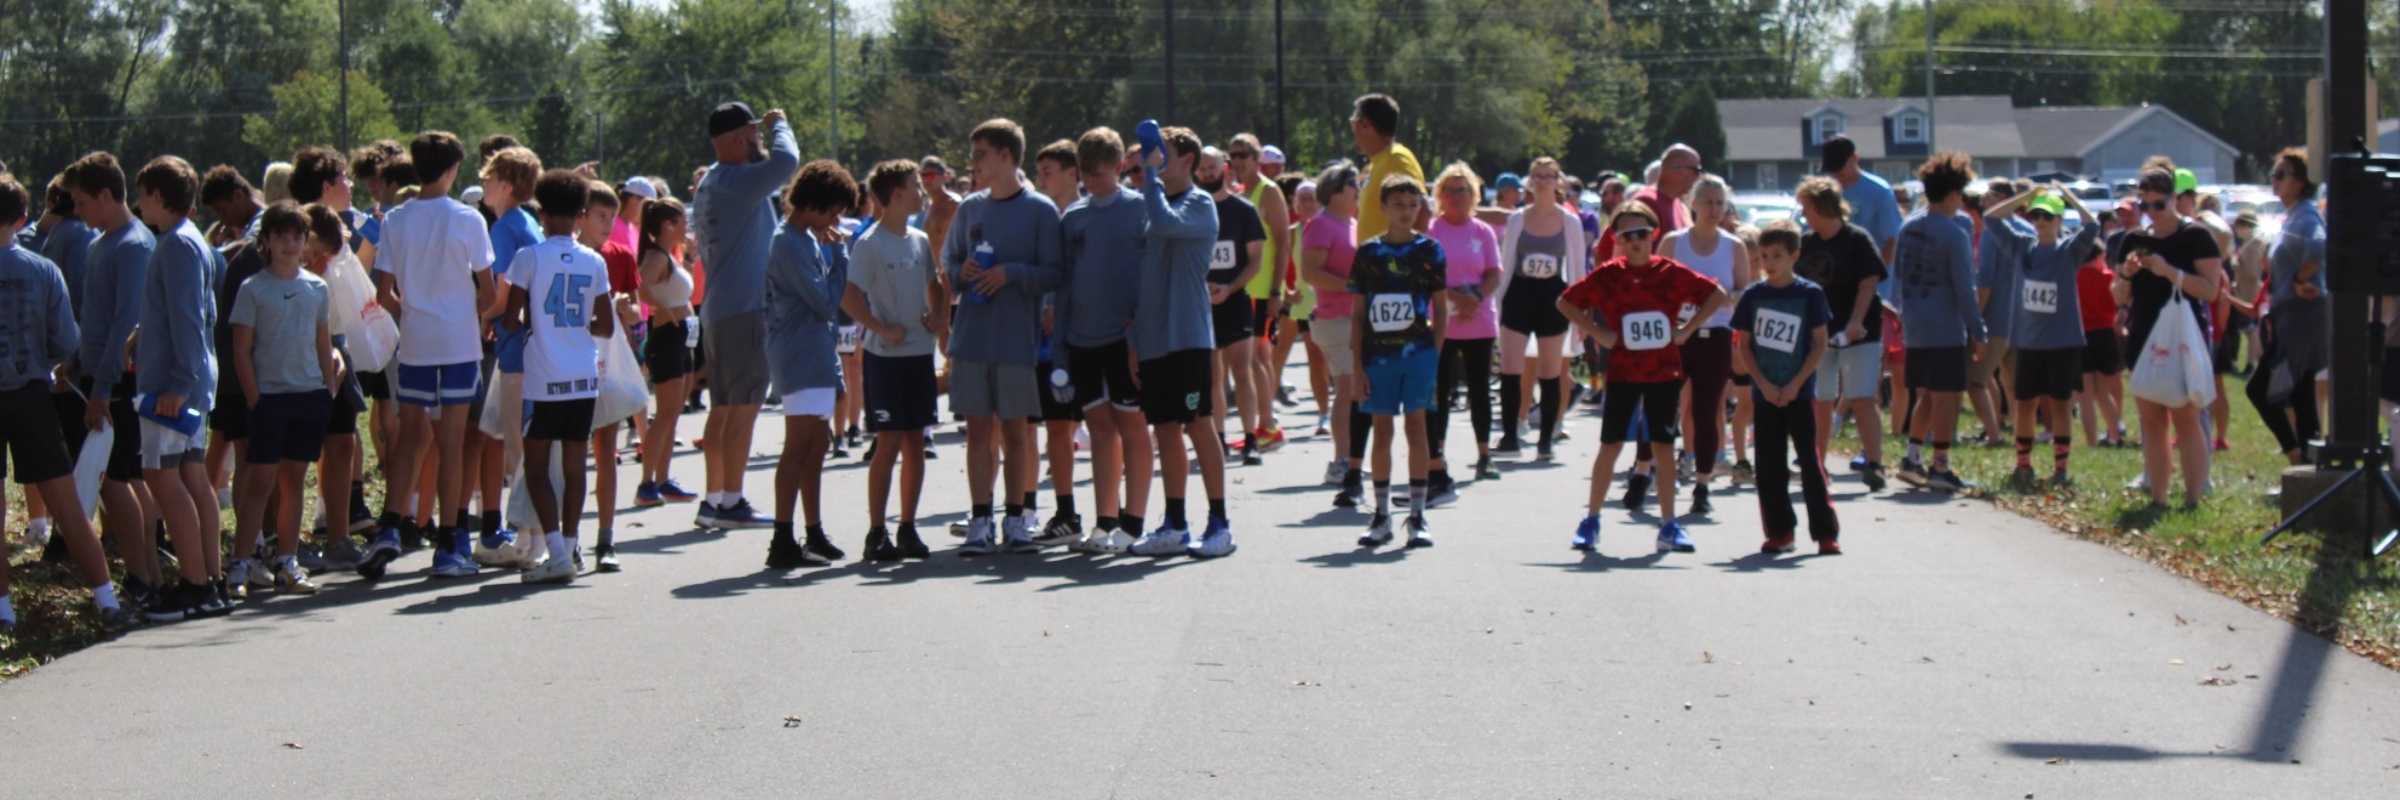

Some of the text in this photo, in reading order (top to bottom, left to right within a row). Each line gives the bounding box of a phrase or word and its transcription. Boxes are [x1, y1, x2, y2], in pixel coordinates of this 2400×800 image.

[1213, 247, 1231, 263] 43
[1528, 259, 1552, 275] 975
[543, 273, 593, 328] 45
[2023, 287, 2056, 306] 1442
[1371, 301, 1413, 324] 1622
[1630, 319, 1664, 342] 946
[1755, 316, 1796, 345] 1621
